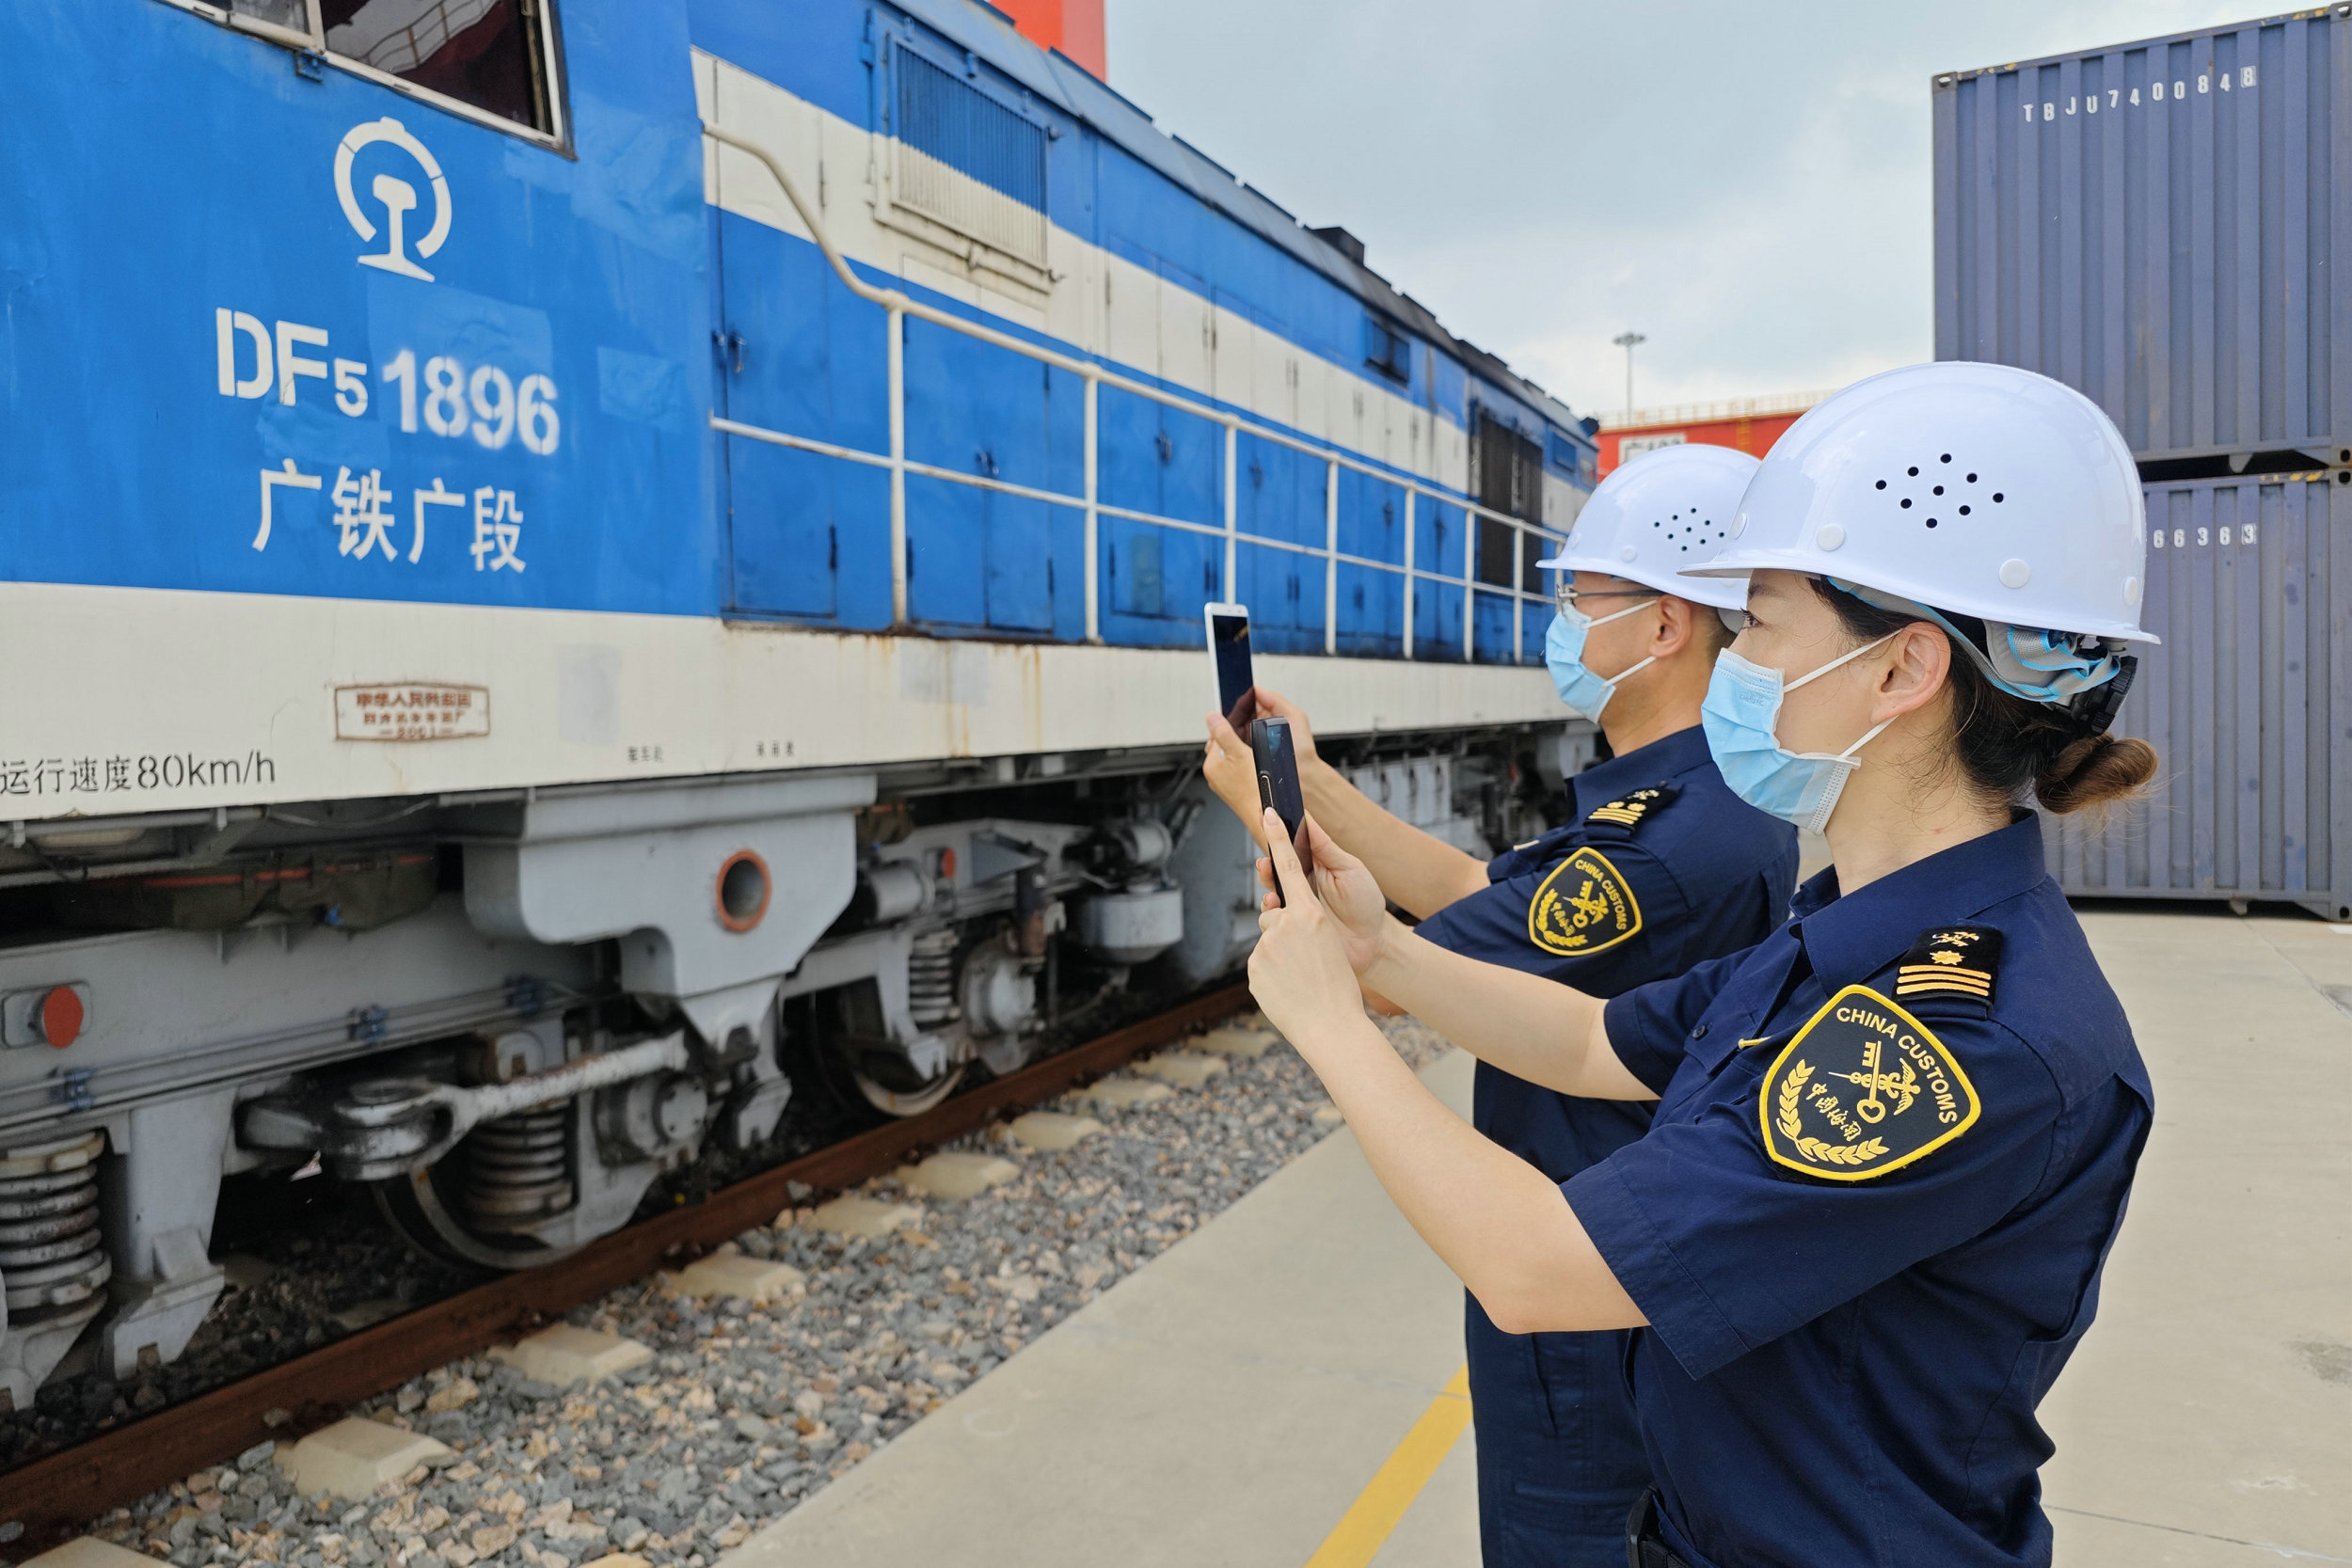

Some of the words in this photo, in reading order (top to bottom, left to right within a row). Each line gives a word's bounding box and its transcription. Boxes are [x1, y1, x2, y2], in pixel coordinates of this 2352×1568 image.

[382, 348, 561, 456] 1896
[251, 458, 526, 574] 广铁广段
[1575, 859, 1604, 882] CHINA
[1601, 879, 1628, 930] CUSTOMS
[1836, 1006, 1899, 1039] CHINA
[1898, 1035, 1959, 1124] CUSTOMS
